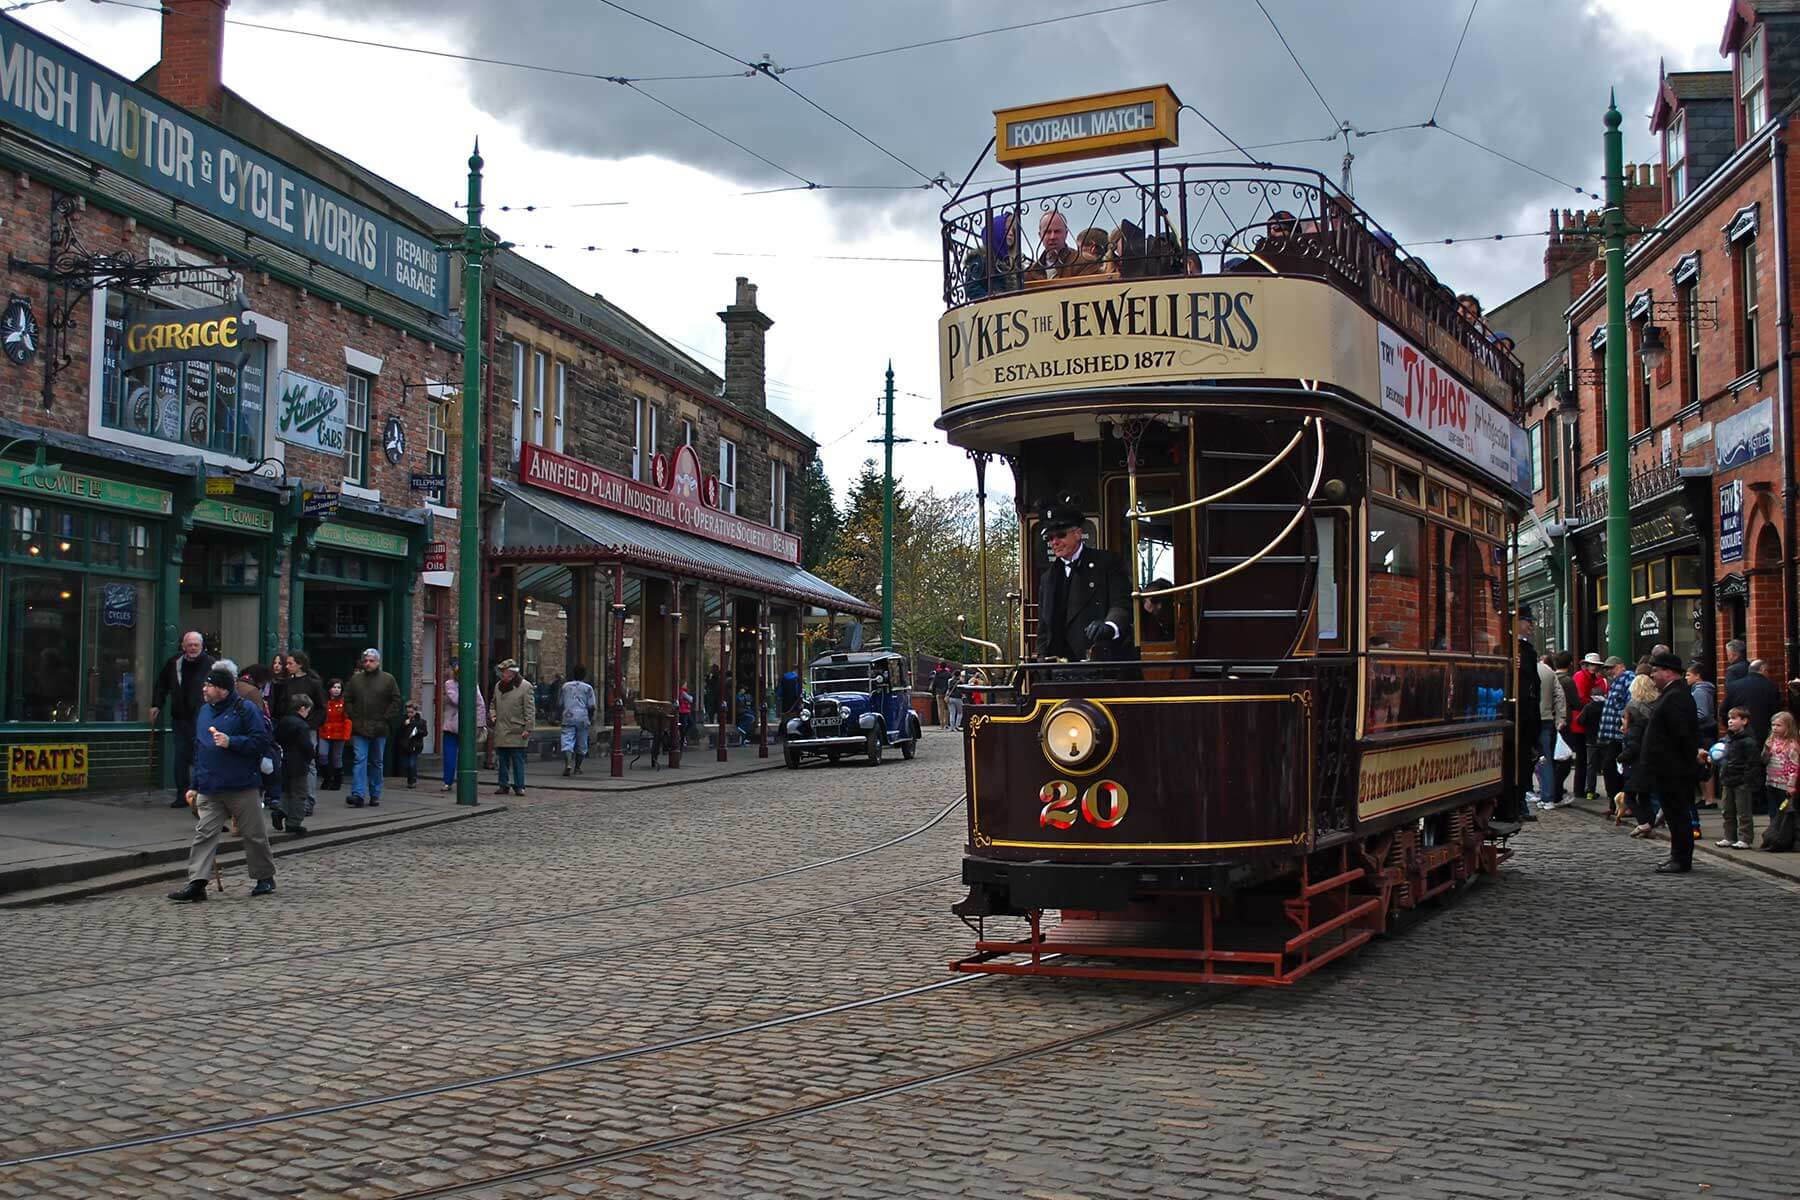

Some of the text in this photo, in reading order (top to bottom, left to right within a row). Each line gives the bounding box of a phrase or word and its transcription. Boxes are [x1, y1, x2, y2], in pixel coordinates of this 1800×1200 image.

[1013, 107, 1145, 148] FOOTBALL MATCH
[89, 81, 195, 188] MOTOR
[201, 150, 212, 183] &
[219, 148, 294, 233] CYCLE
[301, 188, 377, 270] WORKS
[396, 236, 437, 274] REPAIRS
[396, 262, 436, 298] GARAGE
[1370, 274, 1408, 328] OXTON
[128, 317, 237, 352] GARAGE
[948, 288, 1259, 384] PYKES THE JEWELLERS
[994, 350, 1176, 384] ESTABLISHED 1877
[1380, 341, 1394, 366] TRY
[215, 381, 236, 395] CYCLES
[280, 384, 338, 432] Humber
[318, 421, 342, 450] CARS
[1464, 435, 1474, 453] TEA
[412, 479, 445, 487] TELEPHONE
[529, 450, 589, 492] ANNFIELD
[590, 471, 623, 503] PLAIN
[624, 483, 675, 520] INDUSTRIAL
[678, 502, 735, 539] CO-OPERATIVE
[736, 522, 766, 546] SOCIETY
[232, 507, 259, 527] COWIE
[1723, 516, 1737, 531] MILK
[1720, 531, 1742, 550] CHOCOLATE
[108, 611, 131, 620] CYCLES
[12, 747, 85, 773] PRATT'S
[1359, 747, 1502, 803] BIRKENHEAD CORPORATION TRAMWAYS
[11, 772, 86, 789] PERFECTION SPIRIT
[1039, 779, 1129, 830] 20
